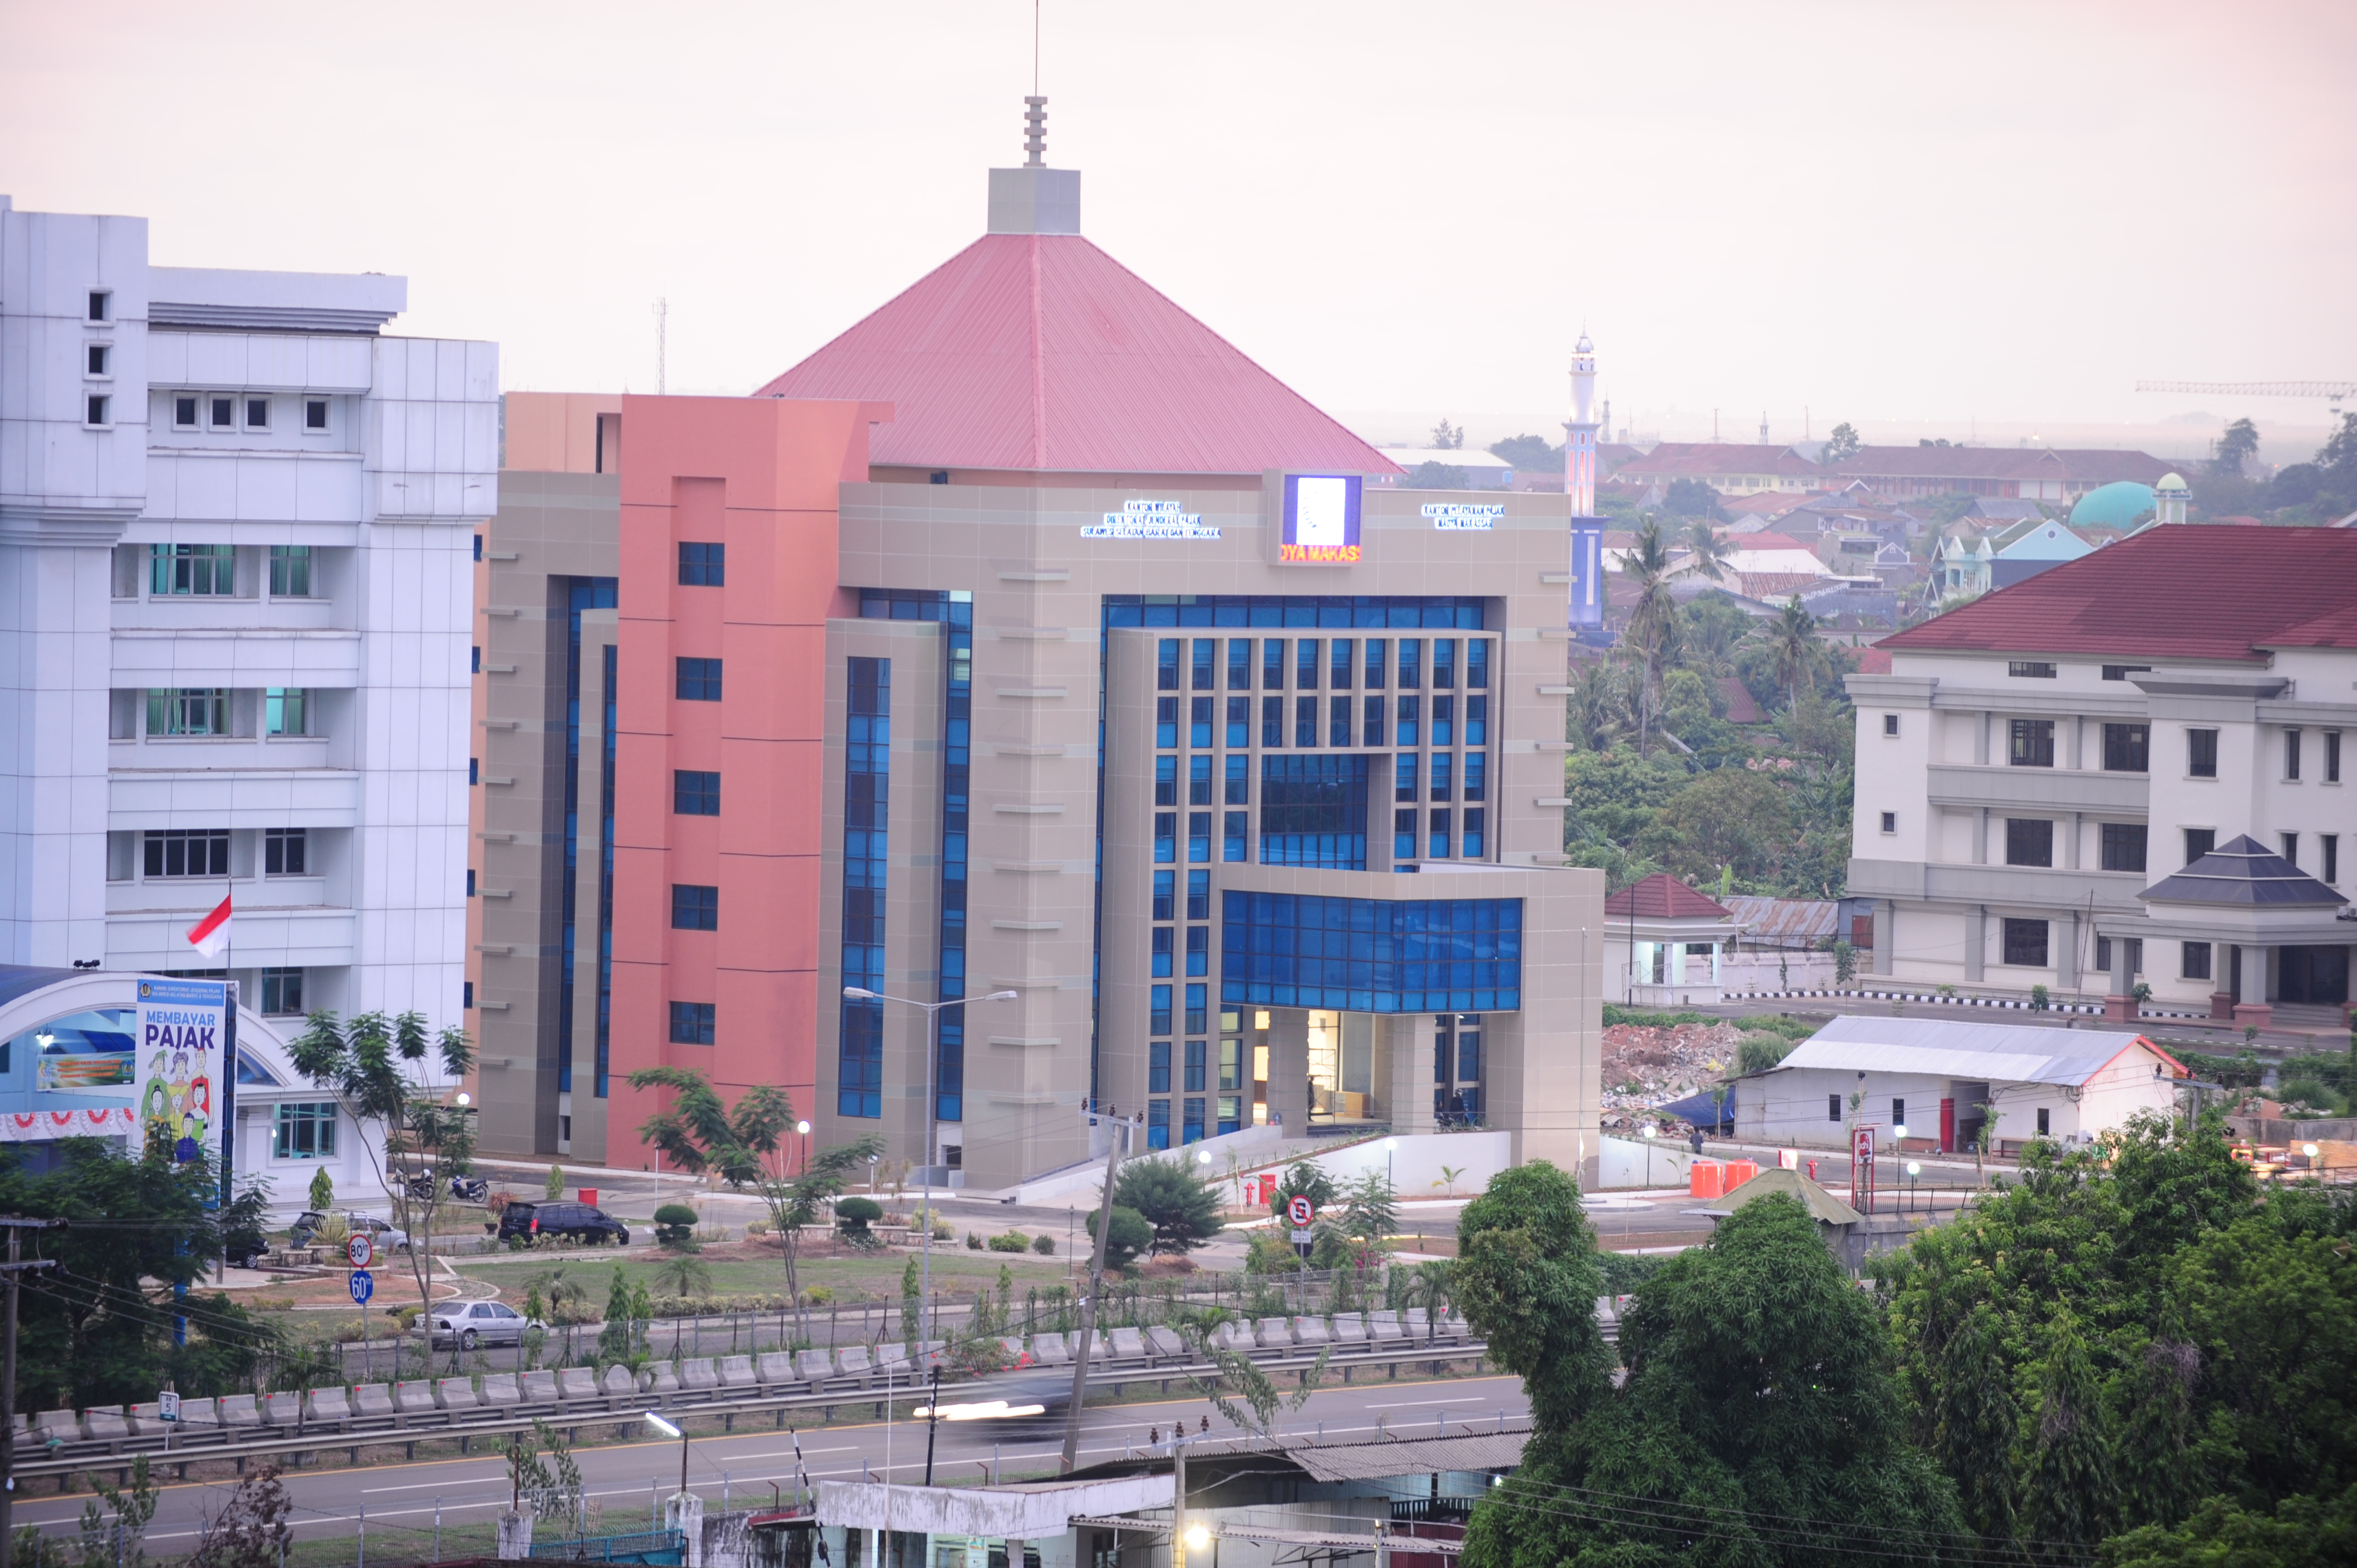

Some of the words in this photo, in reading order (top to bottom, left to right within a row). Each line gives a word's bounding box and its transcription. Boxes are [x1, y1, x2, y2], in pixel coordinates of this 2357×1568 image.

[1125, 502, 1152, 512] KANTOR
[1154, 502, 1181, 513] WILAYAH
[1422, 504, 1448, 516] KANTOR
[1484, 505, 1504, 517] PAJAK
[1105, 514, 1145, 525] DIREKTORAT
[1147, 514, 1179, 525] JENDERAL
[1179, 514, 1200, 525] PAJAK
[1435, 517, 1457, 529] MADYA
[1457, 518, 1493, 529] MAKASSAR
[1081, 527, 1114, 537] SULAWESI
[1145, 527, 1168, 538] BARAT
[1169, 528, 1182, 538] DAN
[1183, 528, 1221, 538] TENGGARA
[146, 1010, 215, 1026] MEMBAYAR
[146, 1024, 215, 1051] PAJAK
[351, 1245, 363, 1257] 80
[352, 1276, 366, 1299] 60
[166, 1403, 171, 1412] 5
